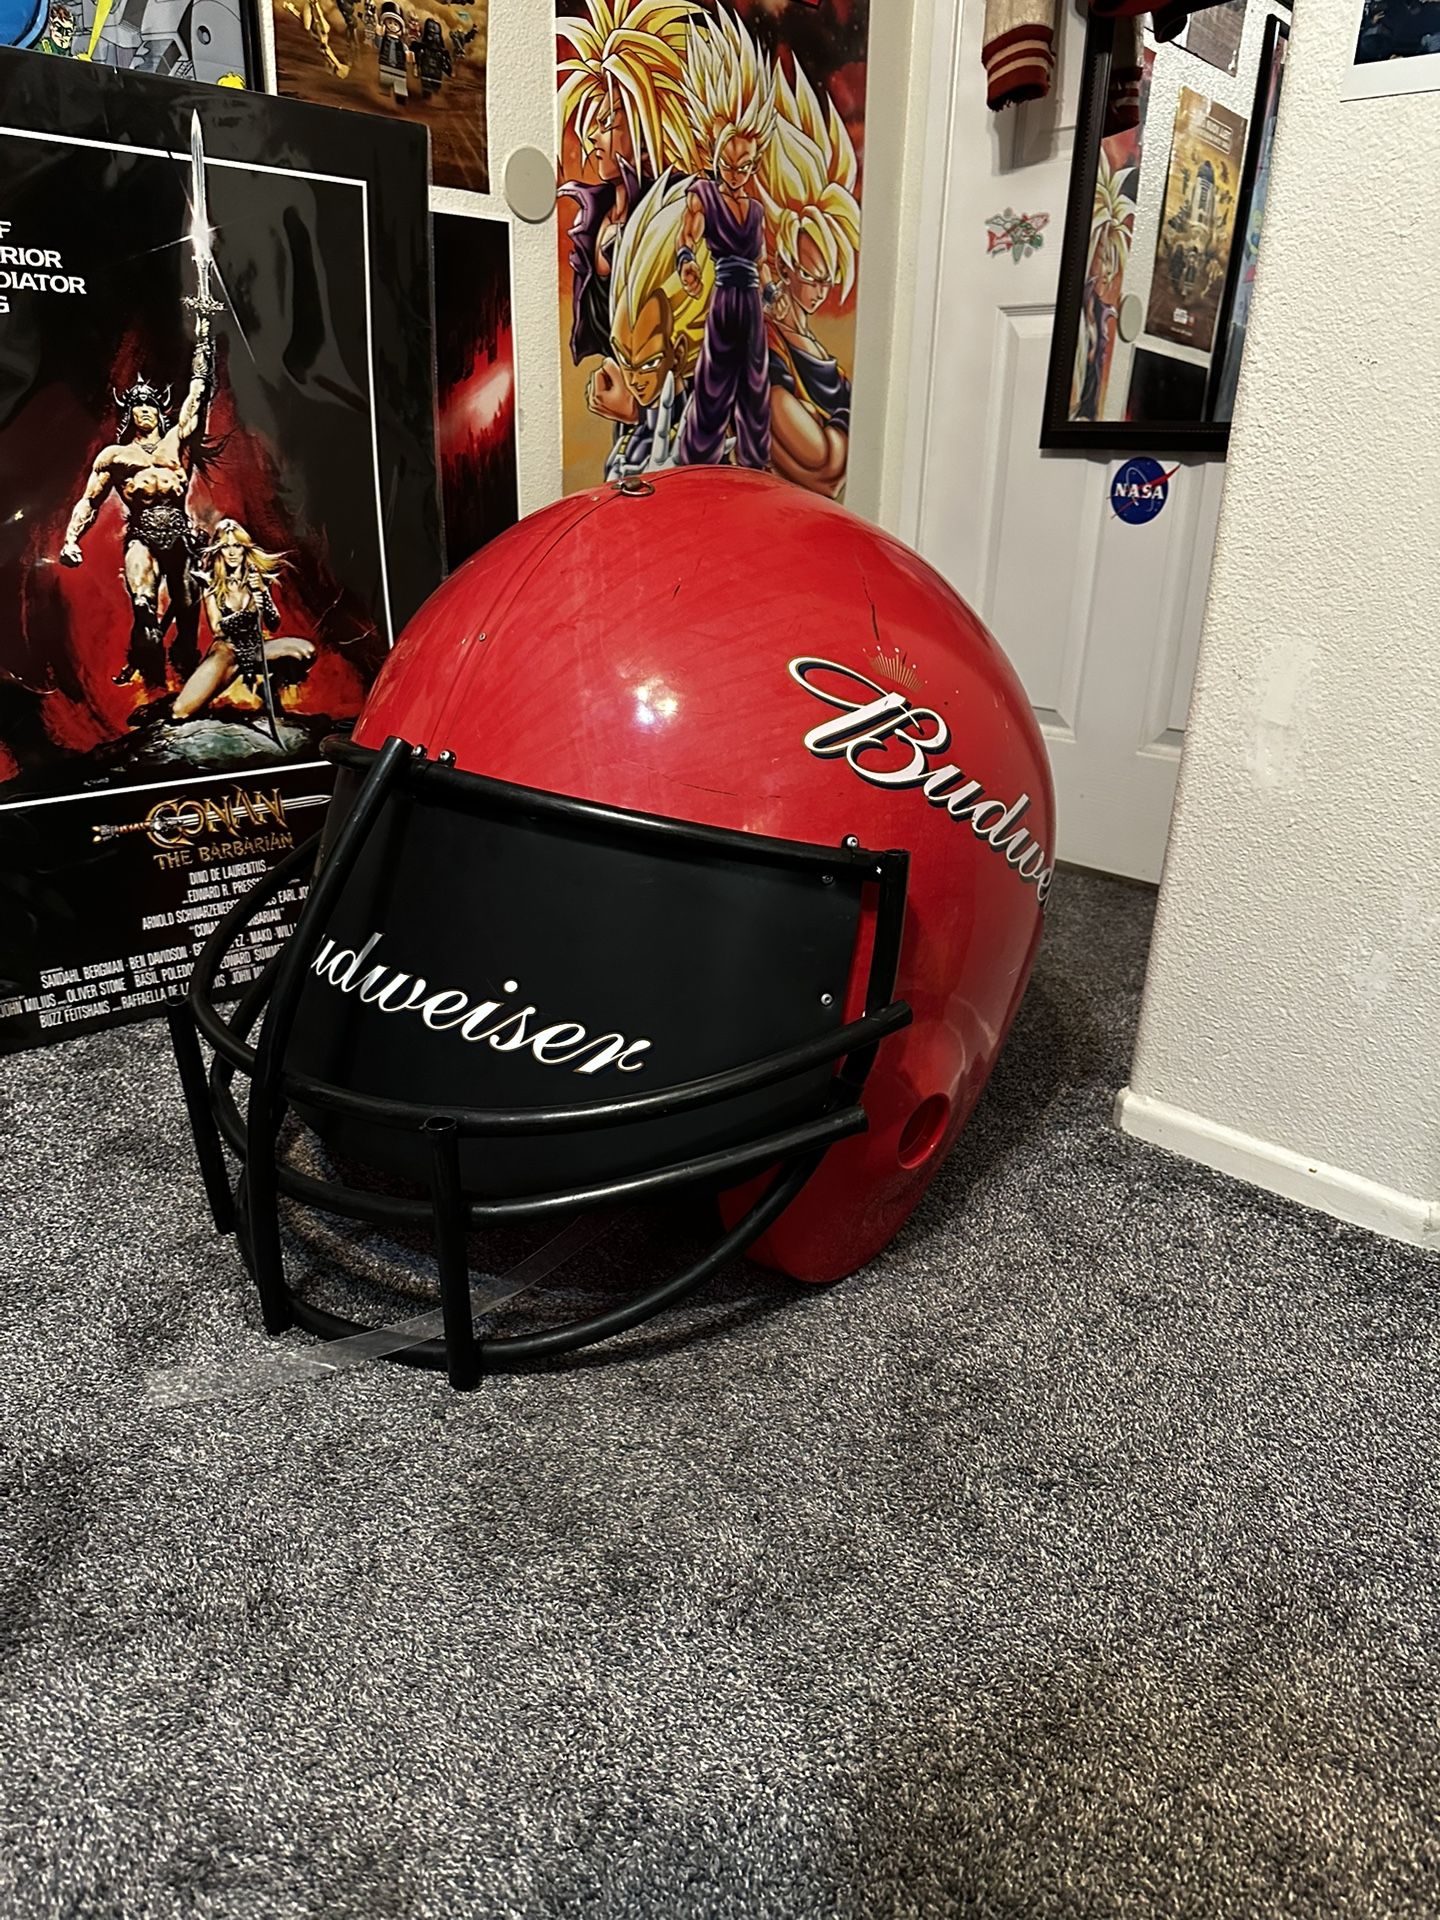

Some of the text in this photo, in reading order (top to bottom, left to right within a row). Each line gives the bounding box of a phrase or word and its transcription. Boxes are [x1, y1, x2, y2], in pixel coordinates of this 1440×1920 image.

[1114, 482, 1165, 500] NASA
[146, 784, 289, 849] CONAN
[153, 830, 296, 871] THE BARBARIAN
[189, 859, 267, 886] DINO DE LAURENTIIS
[142, 907, 175, 931] ARNOLD
[277, 888, 298, 904] EARL
[187, 886, 221, 903] EDWARD
[40, 968, 83, 989] SANDAHL
[83, 959, 125, 980] BERGMAN
[128, 954, 147, 970] BEN
[147, 945, 189, 966] DAVIDSON
[249, 927, 273, 944] MAKO
[24, 993, 57, 1013] MILIUS
[66, 983, 99, 1003] OLIVER
[99, 977, 127, 996] STONE
[134, 970, 161, 988] BASIL
[39, 1011, 64, 1029] BUZZ
[64, 1000, 111, 1023] FEITSHANS
[120, 987, 168, 1010] RAFFAELLA
